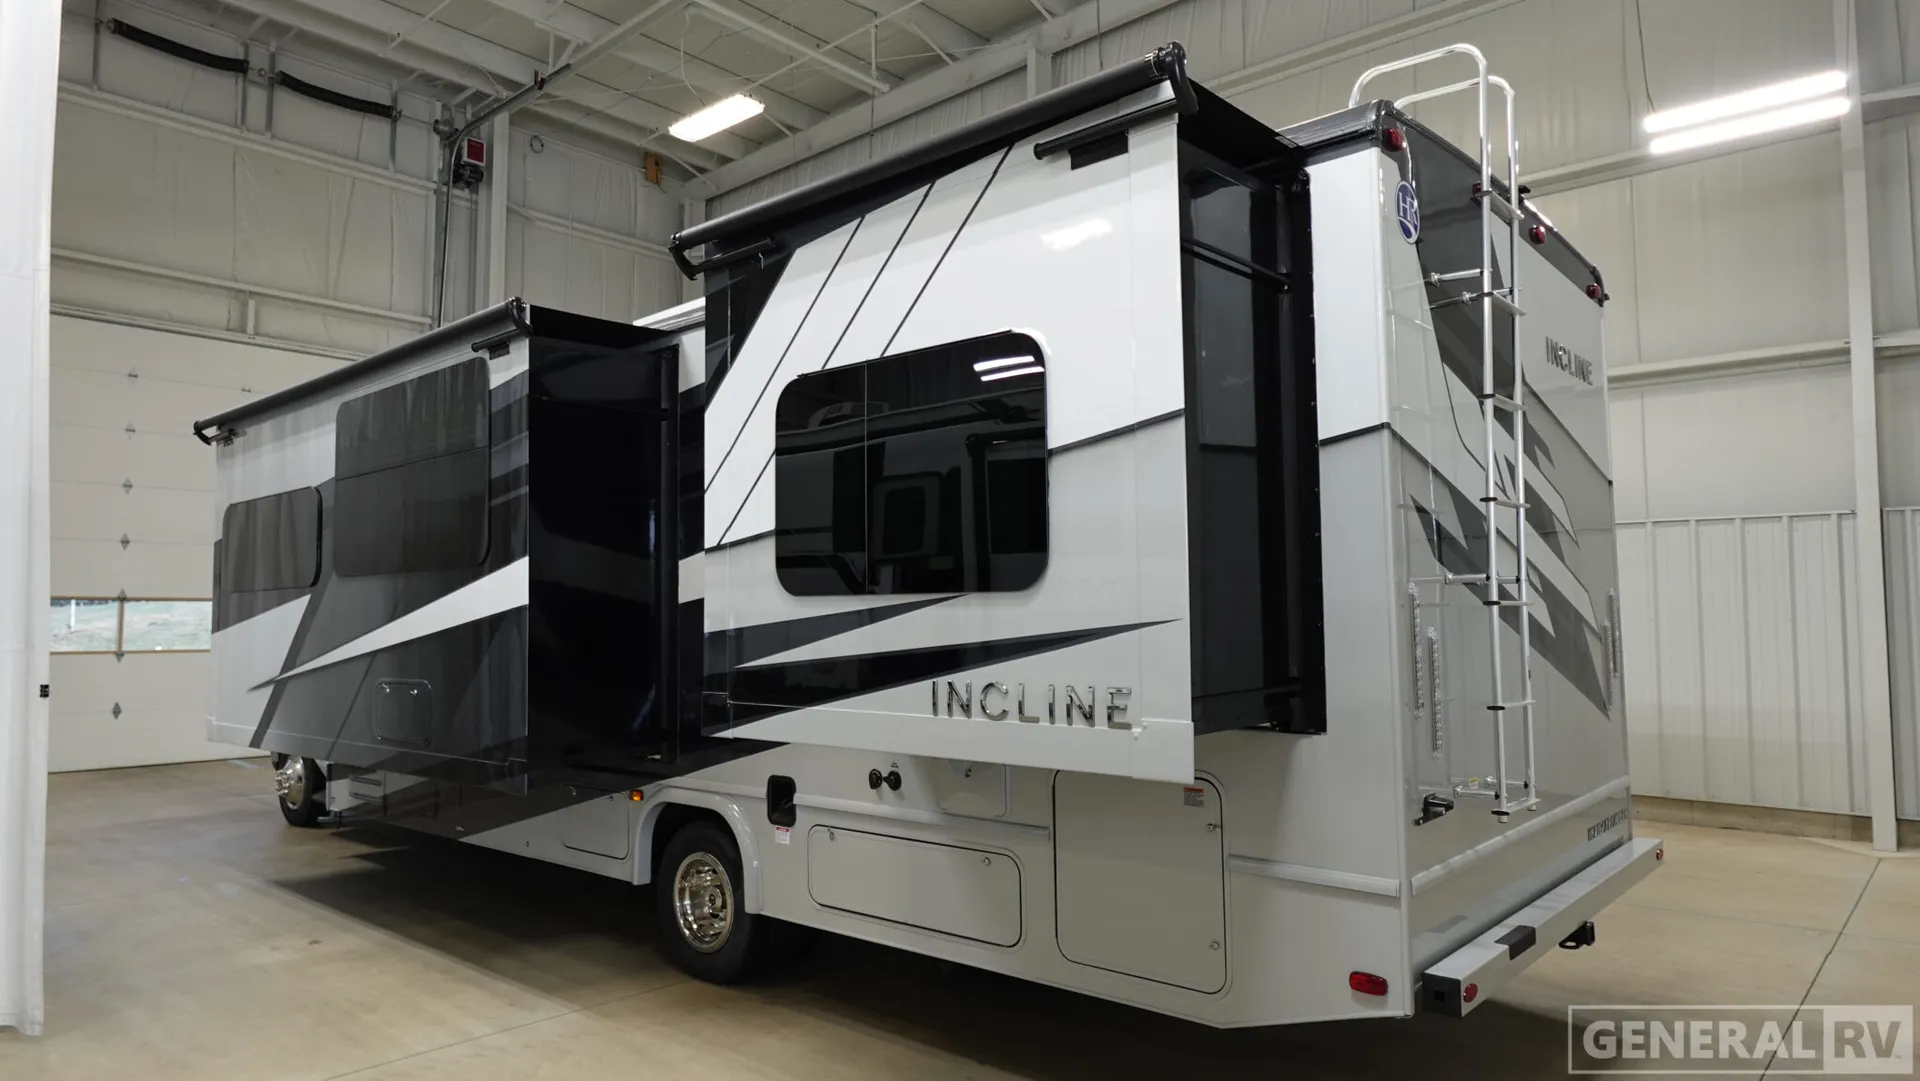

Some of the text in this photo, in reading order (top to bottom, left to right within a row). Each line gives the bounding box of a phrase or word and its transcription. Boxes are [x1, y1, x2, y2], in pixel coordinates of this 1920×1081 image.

[1398, 191, 1419, 226] HR
[1545, 335, 1593, 387] INCLINE
[932, 680, 1133, 730] INCLINE
